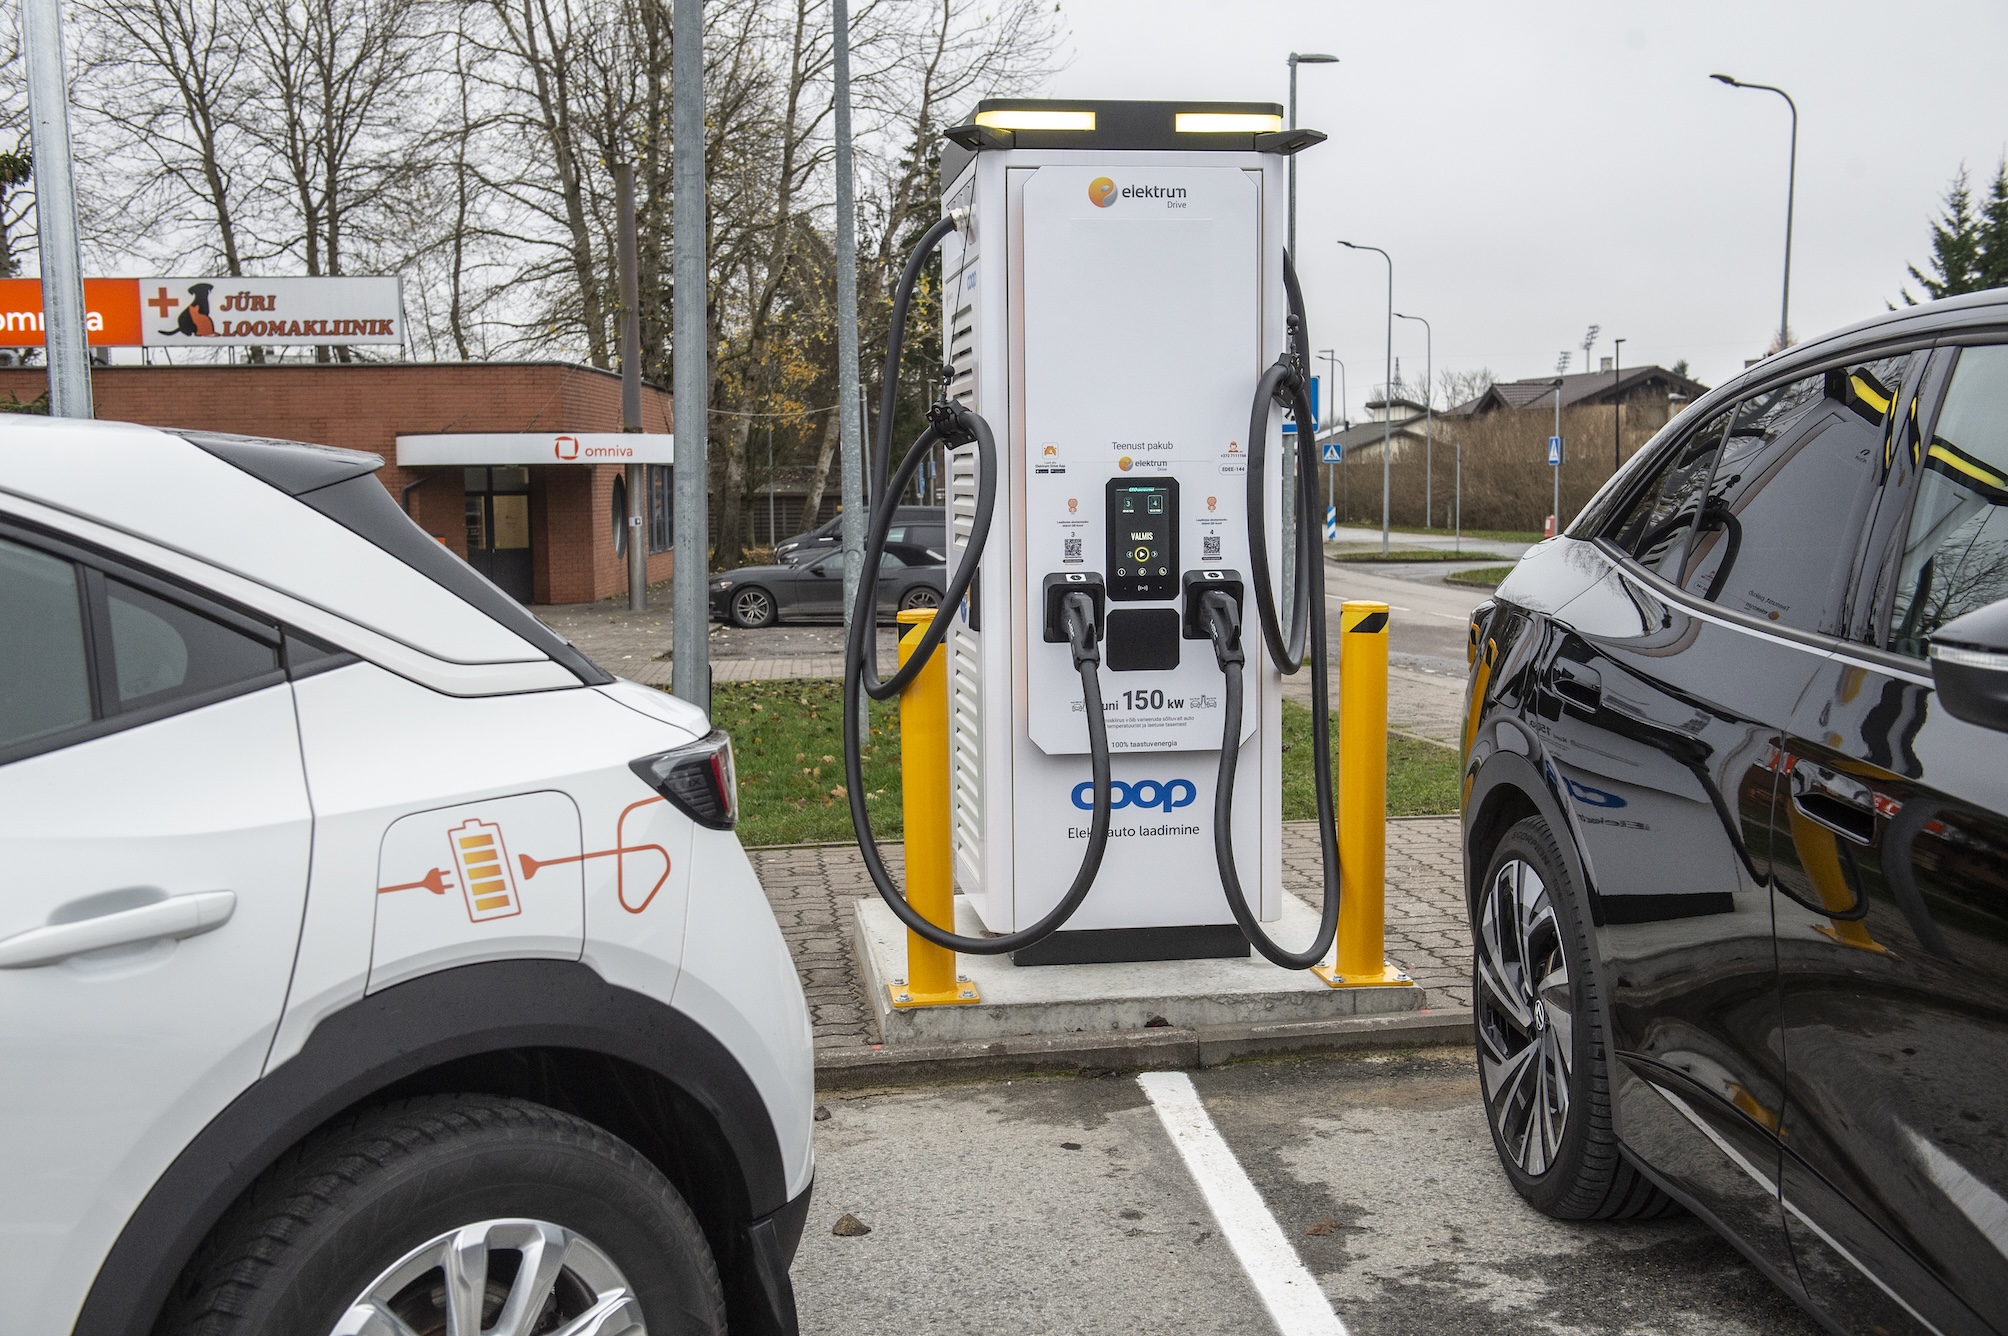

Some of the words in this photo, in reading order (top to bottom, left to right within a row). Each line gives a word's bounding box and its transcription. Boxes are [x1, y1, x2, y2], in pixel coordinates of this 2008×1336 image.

[1121, 184, 1187, 198] elektrum
[220, 291, 276, 312] JÜRI
[222, 318, 395, 338] LOOMAKLIINIK
[585, 445, 633, 457] omniva
[1112, 441, 1145, 450] Teenust
[1147, 441, 1174, 451] pakub
[1130, 532, 1154, 541] VALMIS
[1102, 701, 1119, 710] uni
[1122, 689, 1164, 711] 150
[1167, 699, 1184, 709] kW
[1130, 740, 1178, 749] taastuvenergia
[1139, 824, 1200, 837] laadimine
[1511, 831, 1551, 866] SCORPION
